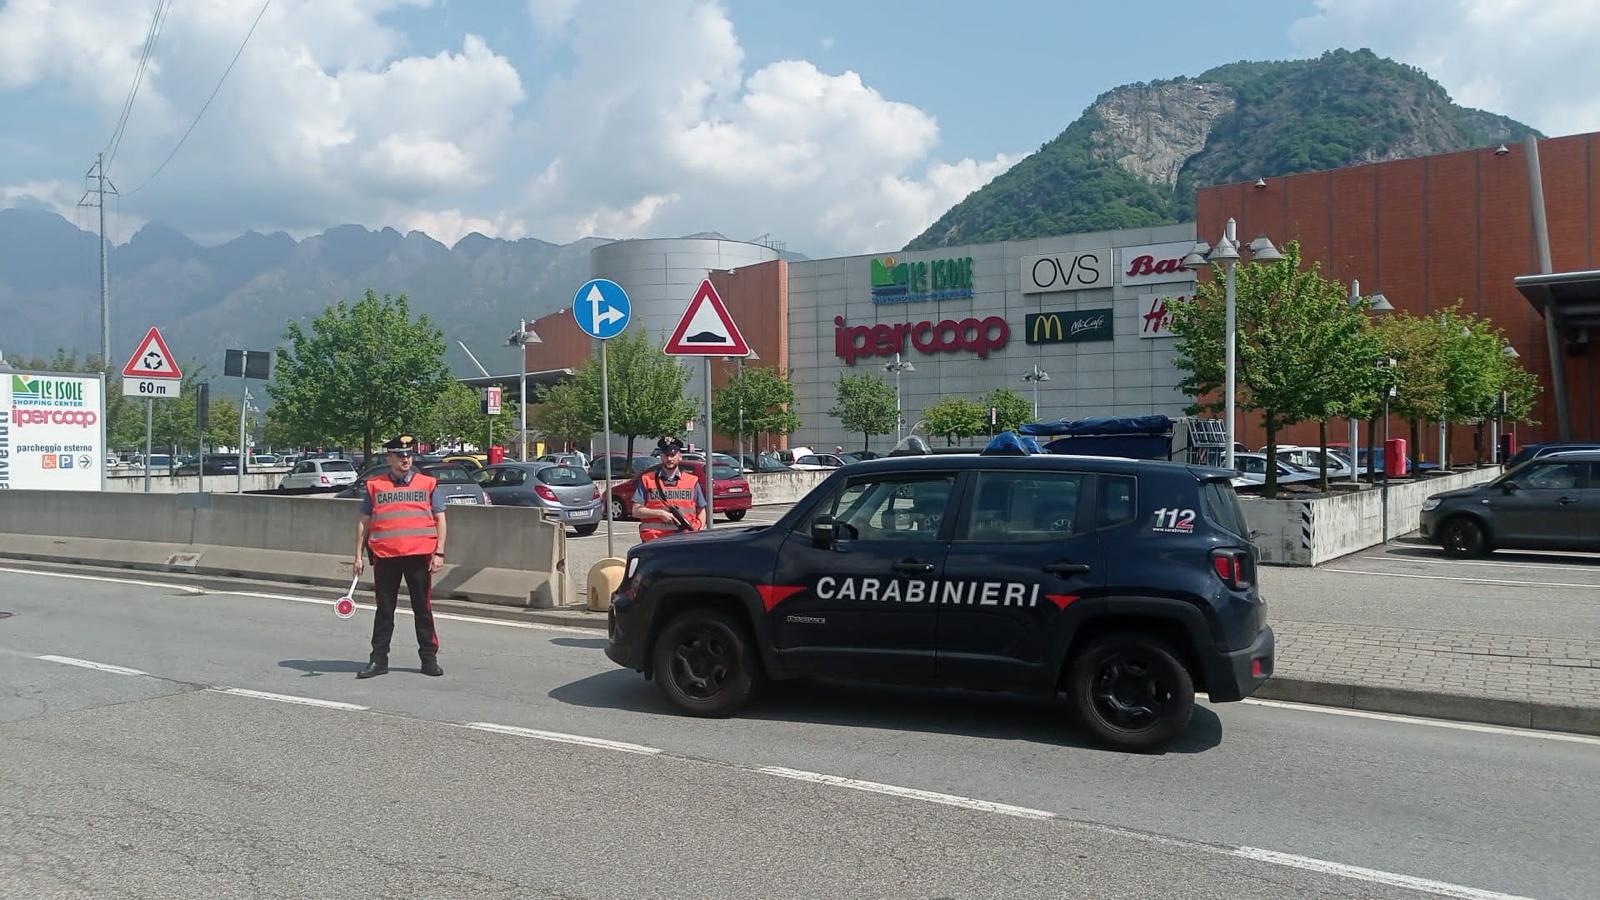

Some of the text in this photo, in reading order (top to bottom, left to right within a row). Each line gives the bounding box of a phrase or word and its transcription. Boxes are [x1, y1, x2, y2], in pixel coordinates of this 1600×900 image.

[1032, 254, 1100, 288] OVS
[1126, 255, 1188, 277] Bat
[834, 316, 1010, 365] ipercoop
[41, 380, 83, 400] Le ISOLE
[139, 381, 166, 394] 60 m
[12, 405, 97, 428] ipercoop
[16, 444, 93, 454] parcheggio esterno
[377, 491, 427, 504] CARABINIERI
[650, 490, 692, 499] CAABINIERI
[1154, 507, 1196, 529] 112
[816, 576, 1040, 607] CARABINIERI
